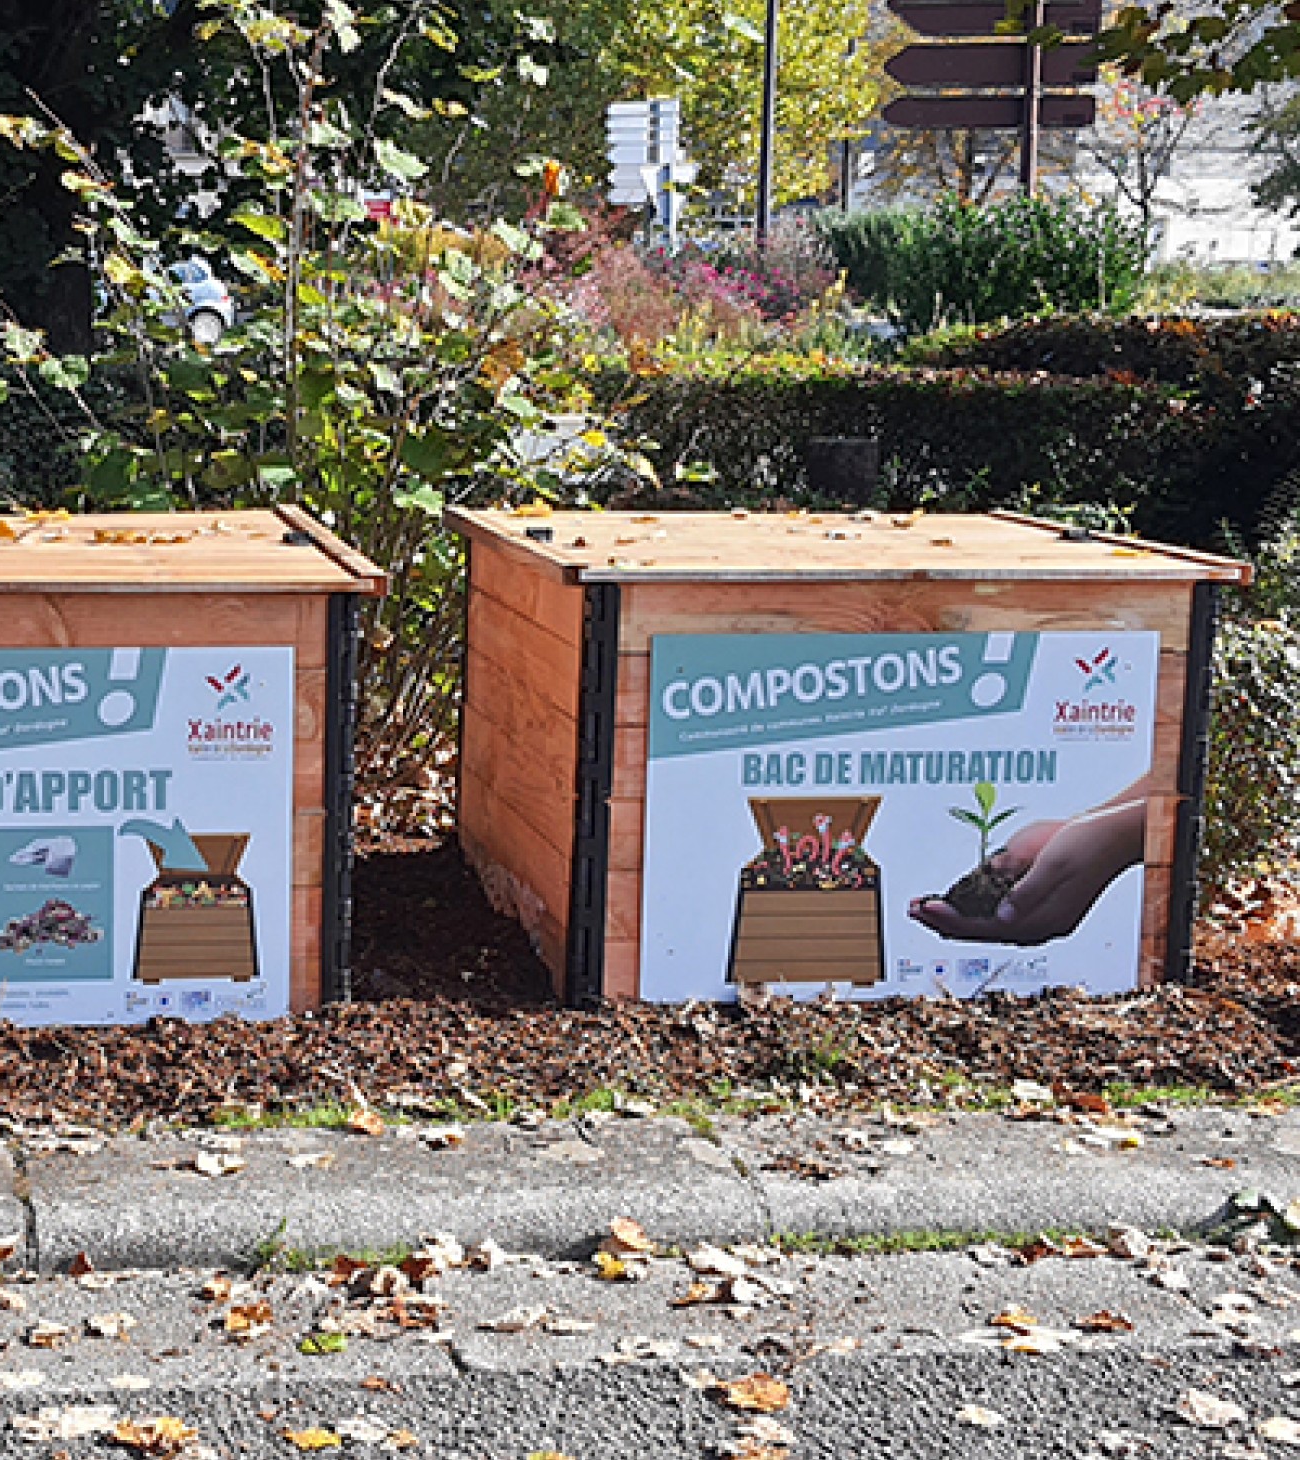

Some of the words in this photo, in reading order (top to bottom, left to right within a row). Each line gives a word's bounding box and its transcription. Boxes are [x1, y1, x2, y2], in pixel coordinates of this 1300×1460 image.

[98, 647, 141, 726] !
[662, 646, 963, 720] COMPOSTONS
[971, 631, 1014, 708] !
[187, 715, 274, 741] Xaintrie
[1053, 698, 1135, 722] Xaintrie
[743, 752, 807, 785] BAC
[815, 751, 852, 784] DE
[860, 749, 1057, 785] MATURATION
